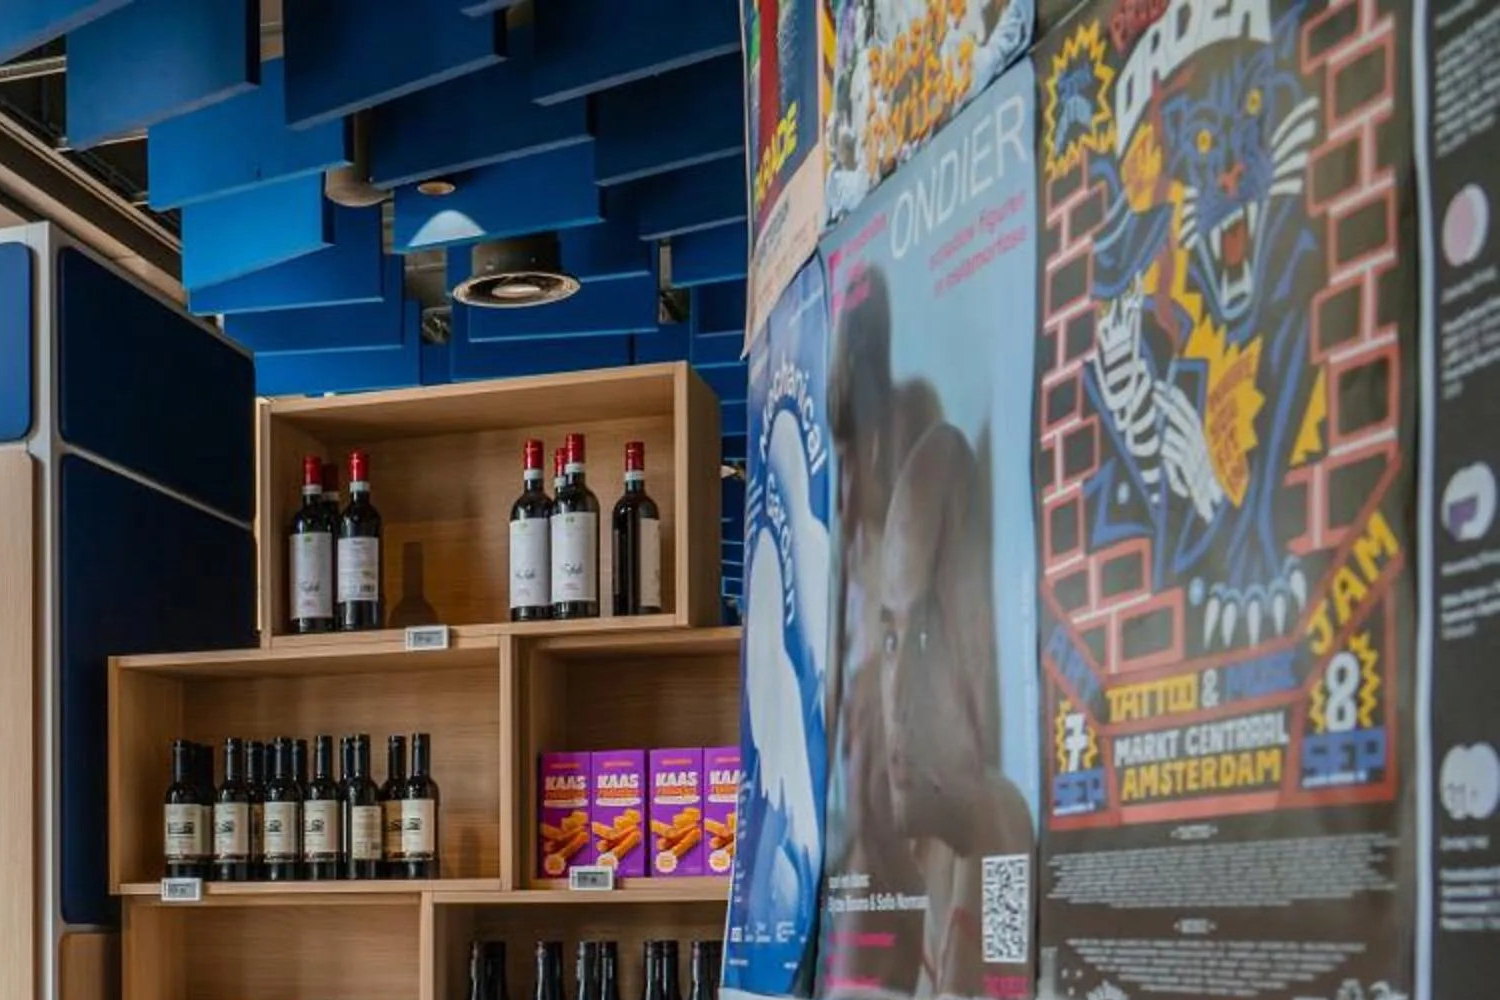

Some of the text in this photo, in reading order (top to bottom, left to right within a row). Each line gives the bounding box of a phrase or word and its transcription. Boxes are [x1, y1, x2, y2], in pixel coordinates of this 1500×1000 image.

[889, 94, 1030, 260] ONDIER
[1306, 510, 1399, 655] JAM
[1201, 668, 1221, 708] &
[1326, 652, 1361, 732] 8
[1114, 730, 1179, 767] MARKT
[546, 776, 587, 790] KAAS
[598, 774, 639, 788] KAAS
[656, 772, 698, 786] KAAS
[710, 770, 740, 785] KAA
[1121, 748, 1283, 801] AMSTERDAM
